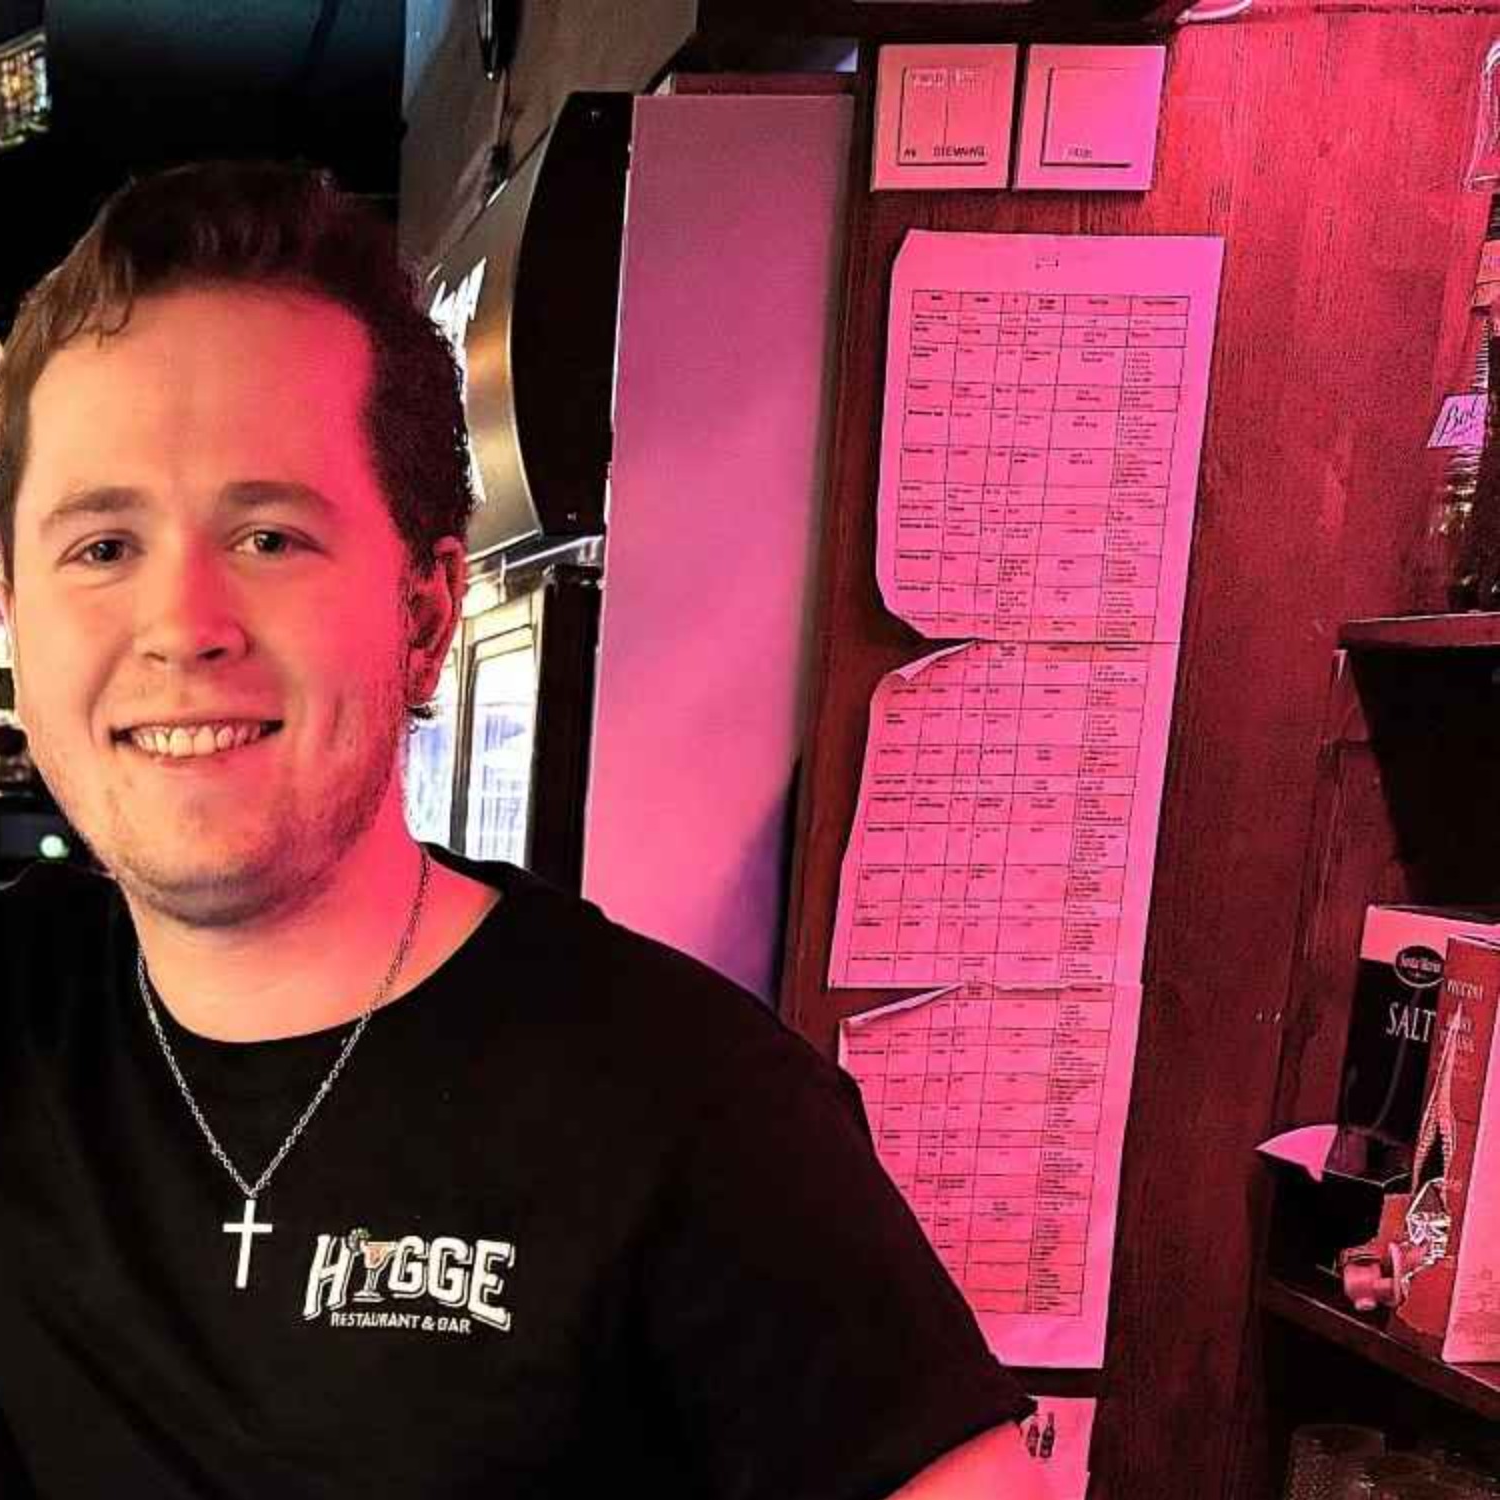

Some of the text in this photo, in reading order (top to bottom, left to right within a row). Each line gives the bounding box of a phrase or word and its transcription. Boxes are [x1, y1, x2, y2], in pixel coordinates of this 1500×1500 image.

[1385, 1001, 1437, 1043] SALT
[303, 1229, 516, 1331] HYGGE
[330, 1311, 472, 1334] RESTAURANT & BAR
